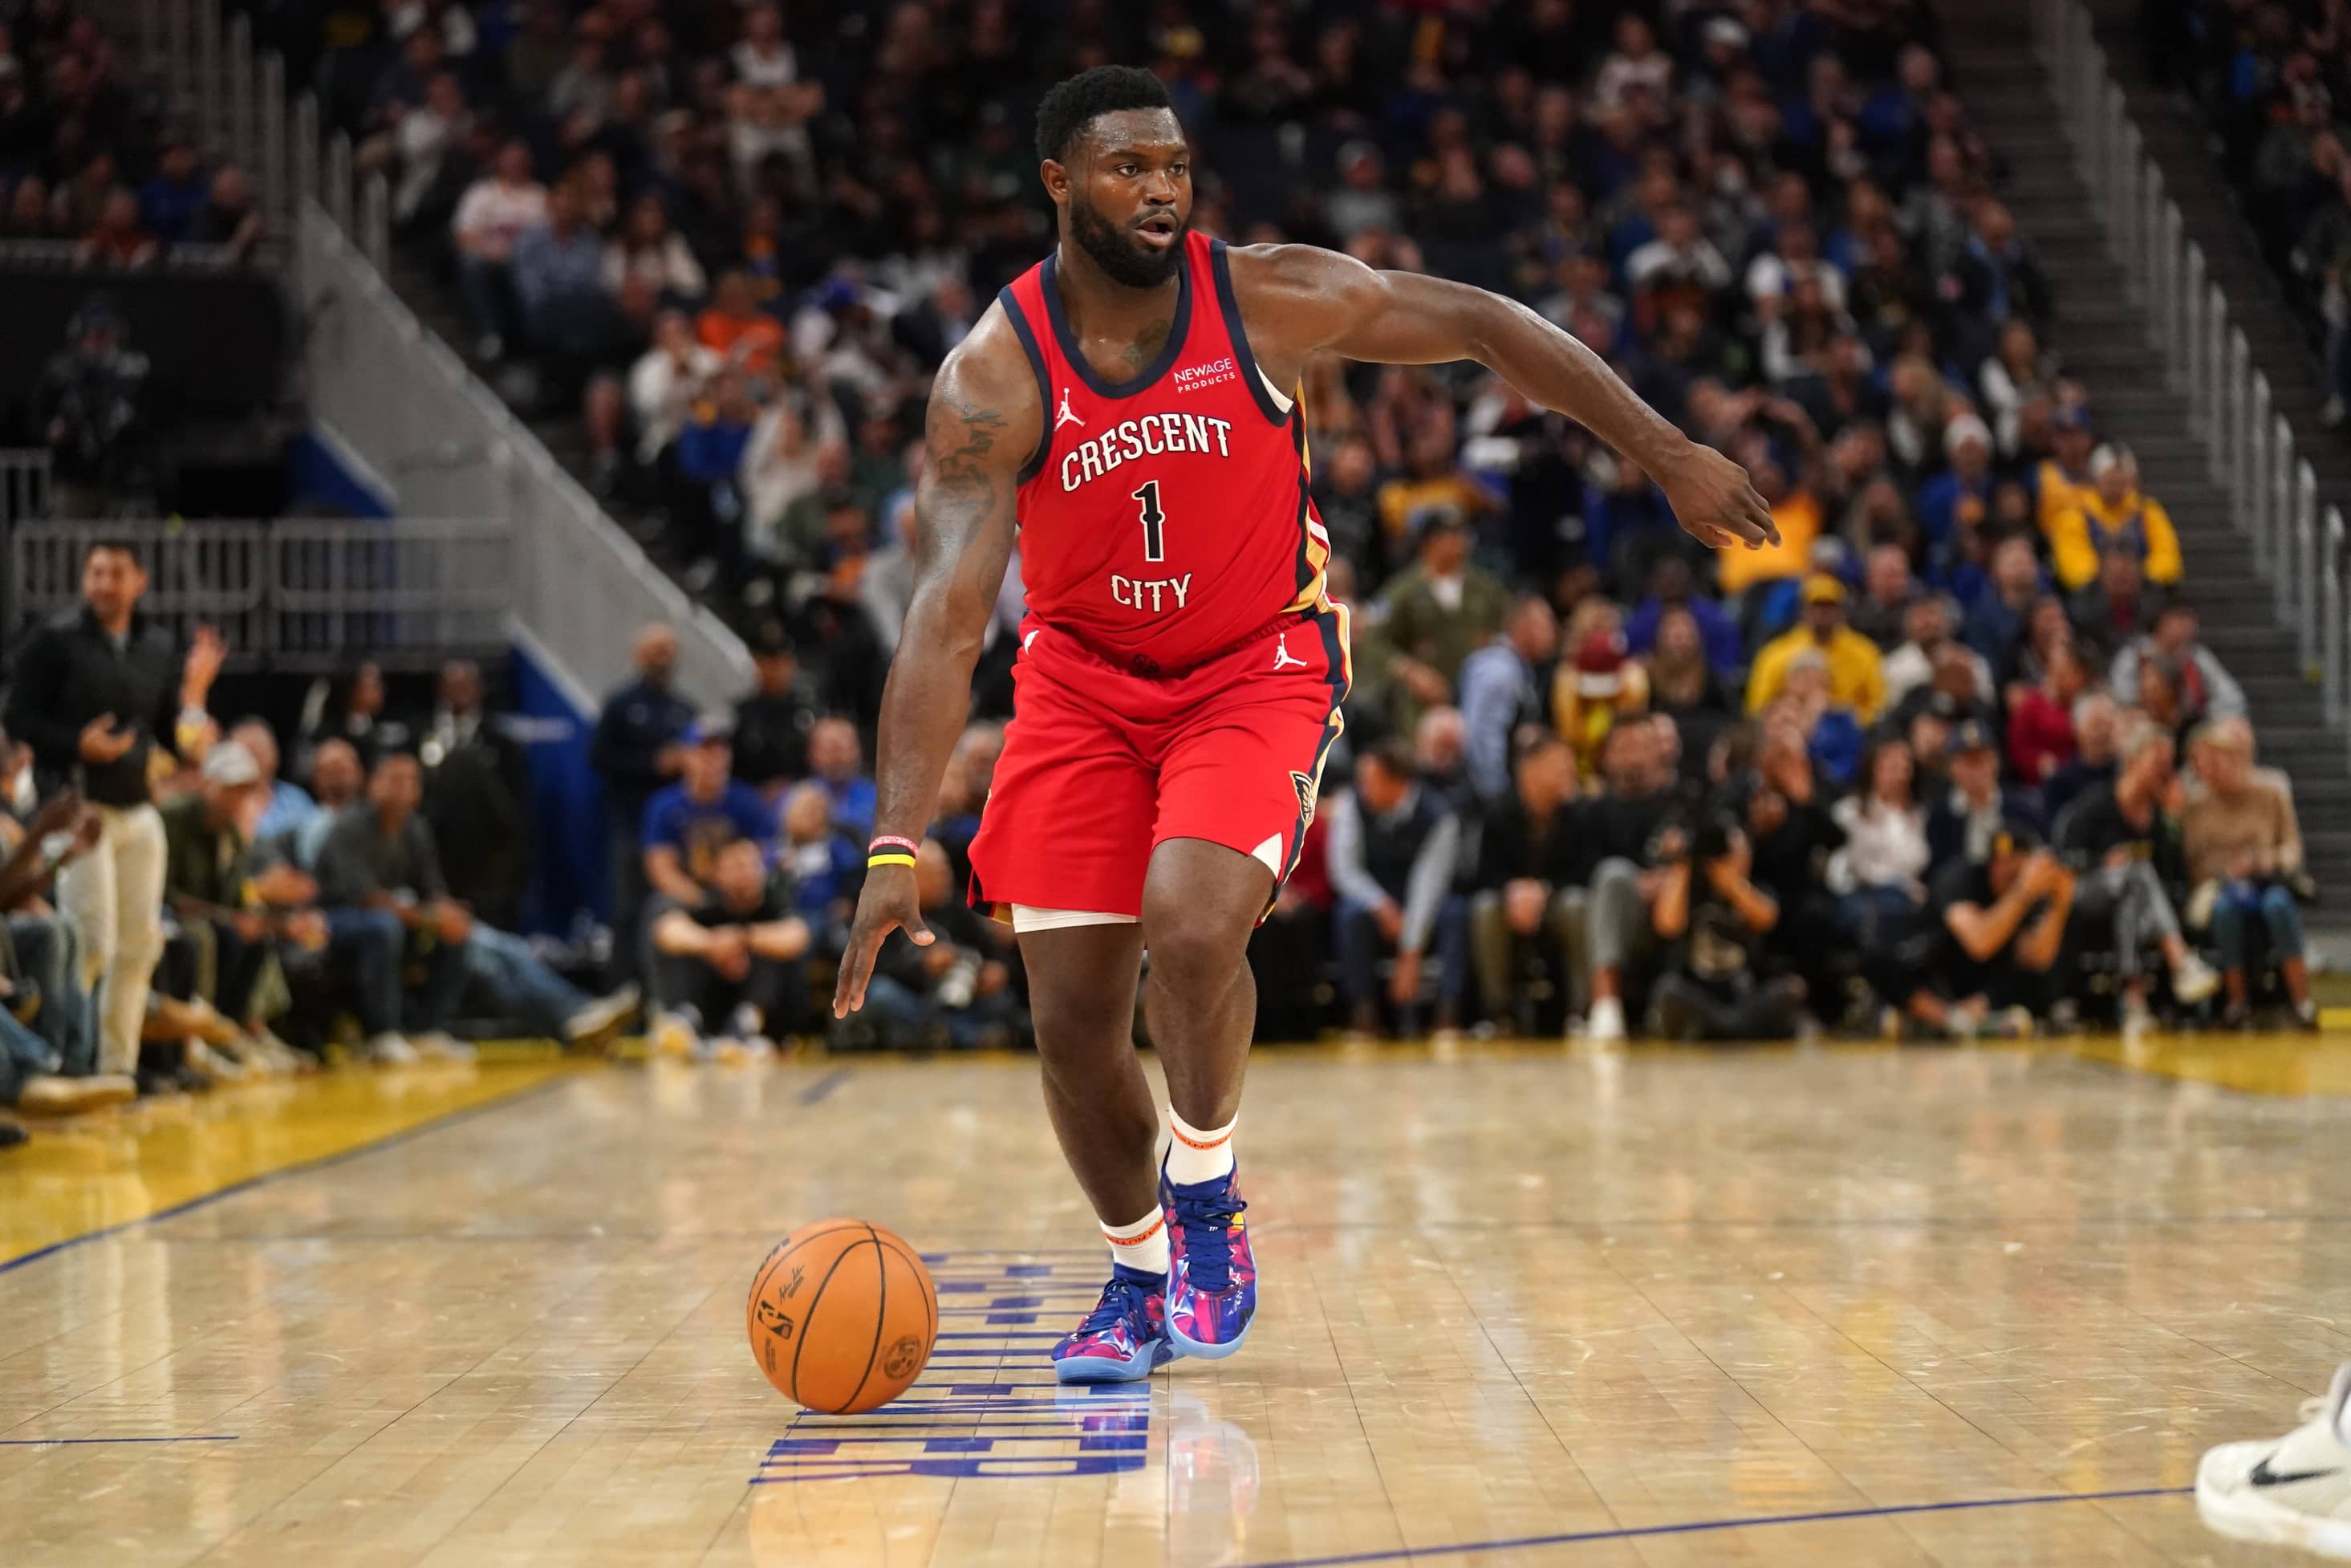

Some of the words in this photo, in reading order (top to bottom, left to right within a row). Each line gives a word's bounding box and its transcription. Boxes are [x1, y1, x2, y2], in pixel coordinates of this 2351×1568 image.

[1174, 358, 1232, 384] NEWAGE
[1177, 372, 1236, 393] PRODUCTS
[1061, 413, 1232, 493] CRESCENT
[1131, 480, 1165, 562] 1
[1111, 573, 1192, 613] CITY
